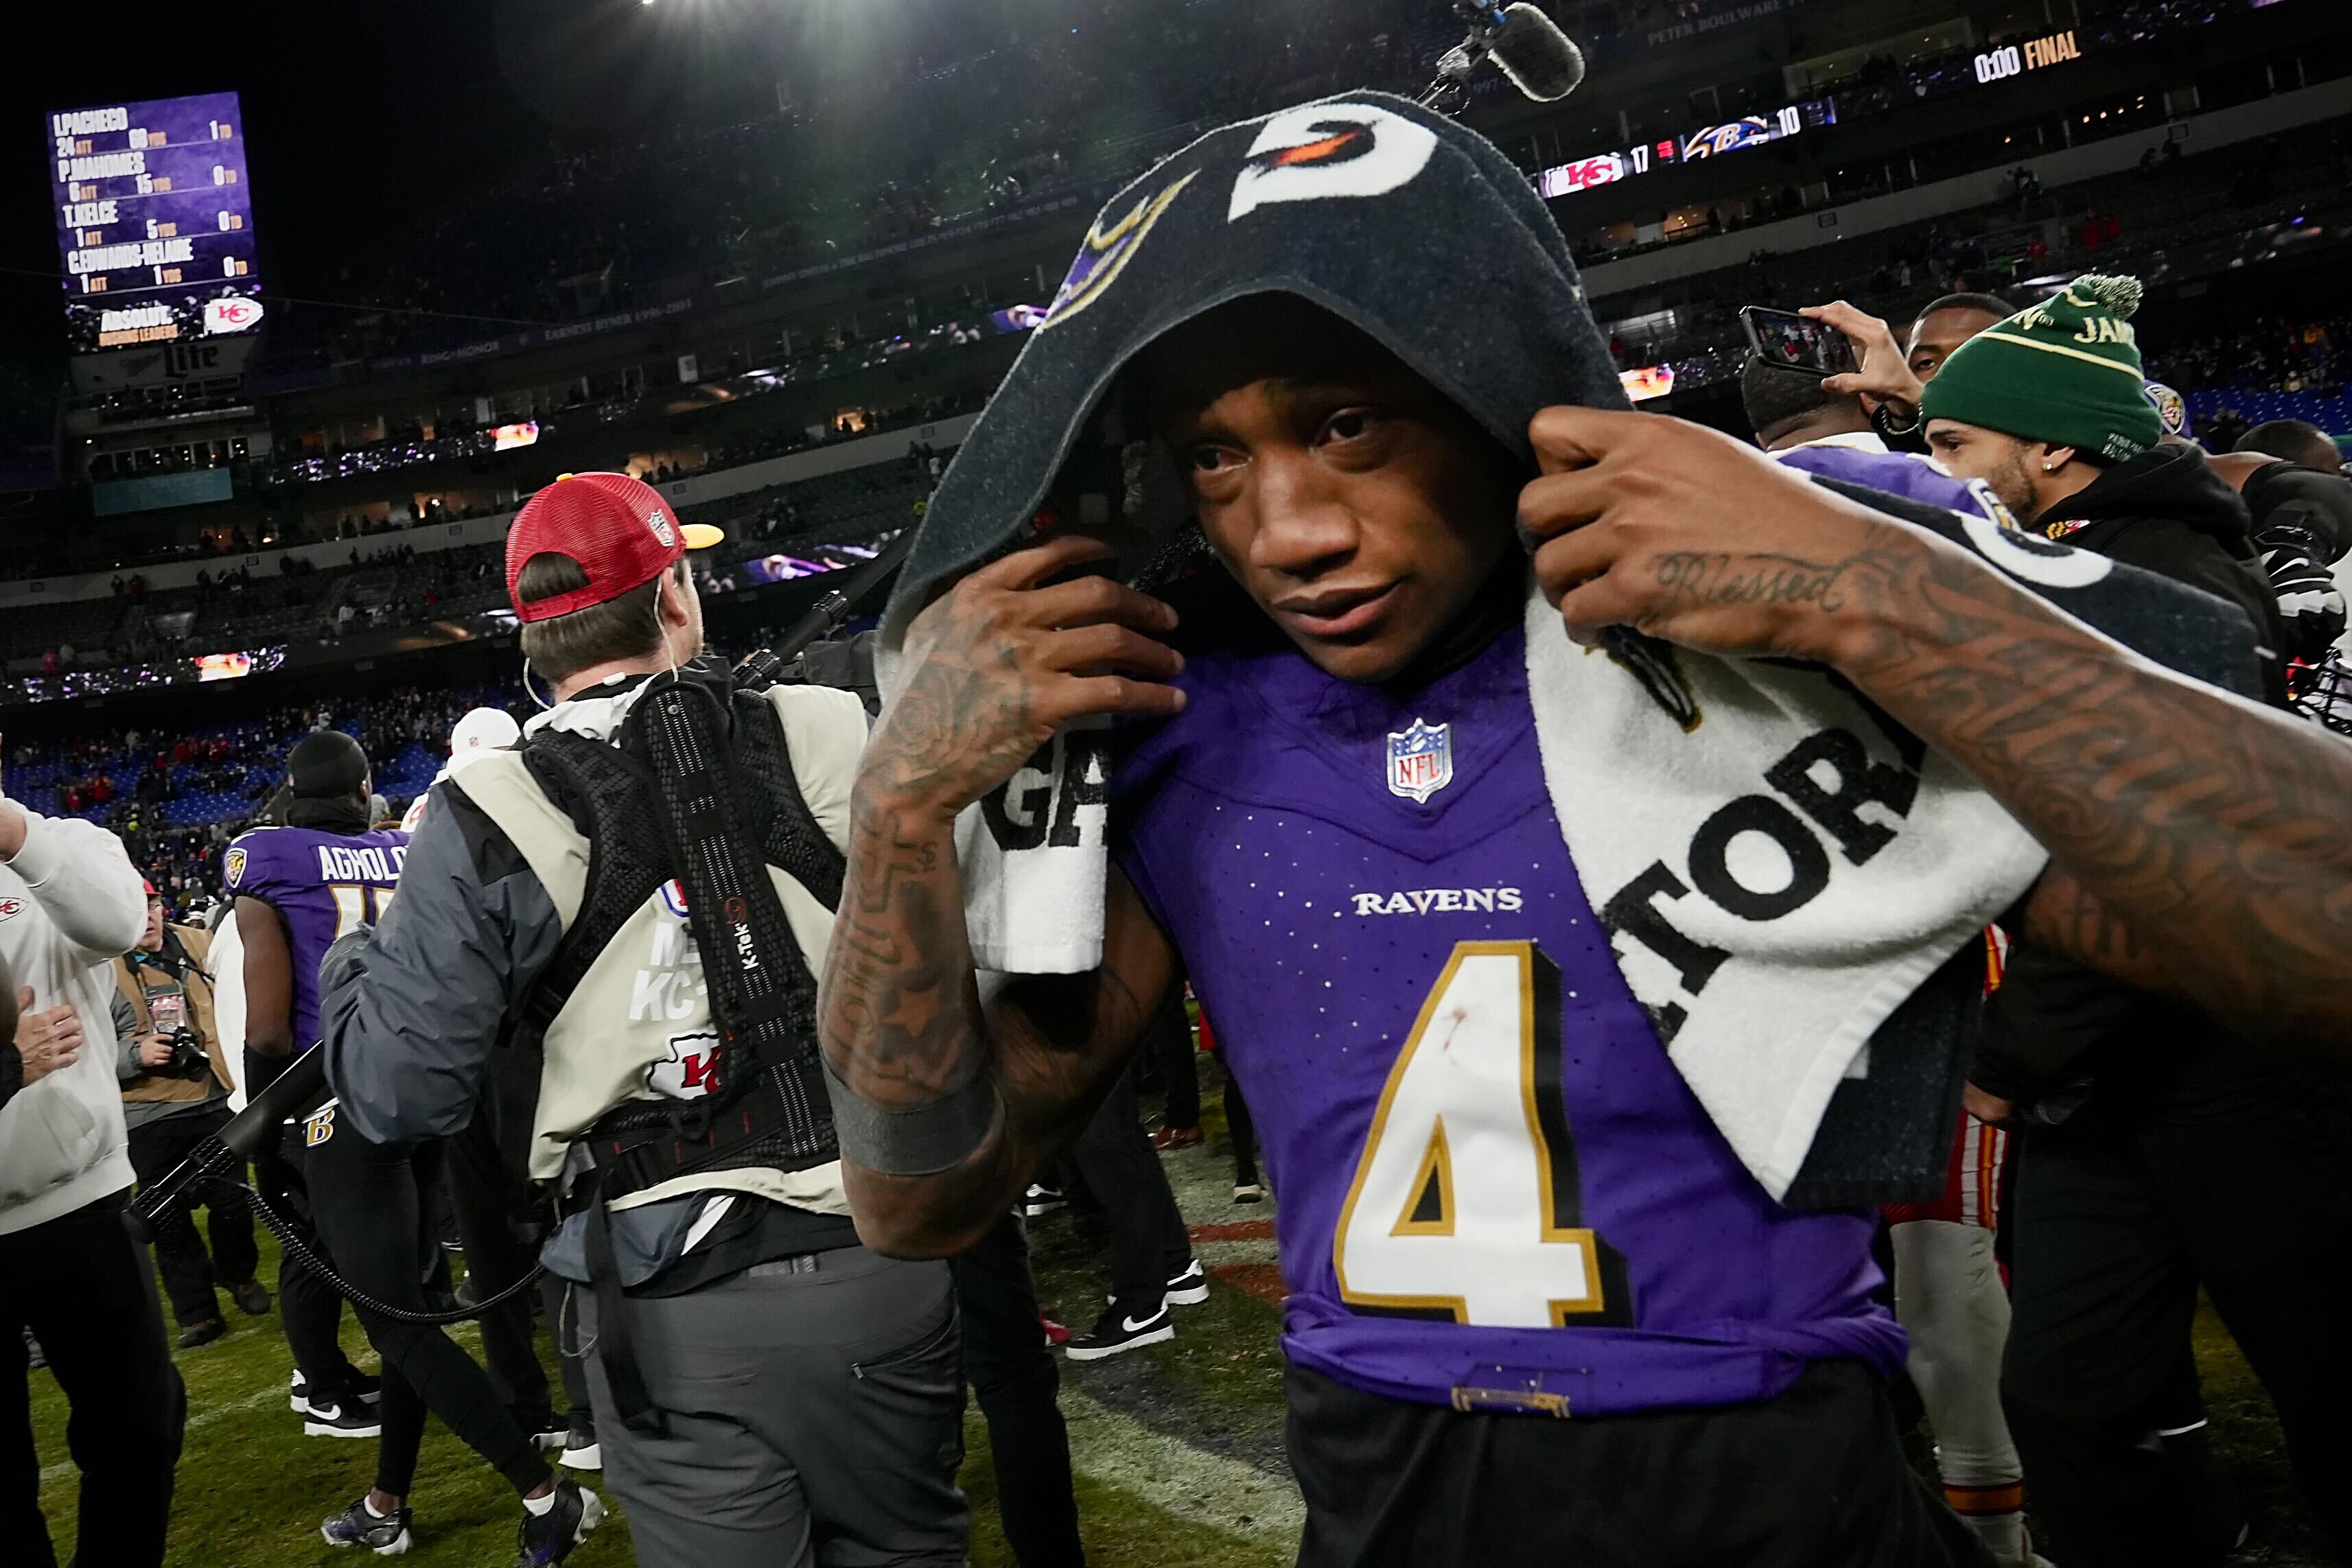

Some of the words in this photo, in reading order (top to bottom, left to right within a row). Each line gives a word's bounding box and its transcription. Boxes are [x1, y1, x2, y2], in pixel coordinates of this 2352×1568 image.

[1974, 45, 2021, 84] 0:00
[2024, 30, 2082, 70] FINAL
[56, 136, 75, 157] 24
[209, 120, 219, 140] 1
[1631, 144, 1649, 174] 17
[1777, 106, 1800, 137] 10
[69, 182, 80, 202] 6
[135, 173, 153, 194] 15
[213, 165, 224, 186] 0
[75, 227, 84, 248] 1
[146, 219, 159, 239] 5
[218, 211, 230, 231] 0
[80, 273, 90, 294] 1
[153, 265, 163, 285] 1
[223, 256, 235, 277] 0
[163, 345, 219, 377] Lite
[1399, 752, 1441, 786] NFL
[1350, 888, 1523, 916] RAVENS
[1600, 727, 1922, 1047] TOR
[306, 1108, 336, 1148] B
[1334, 940, 1606, 1330] 4
